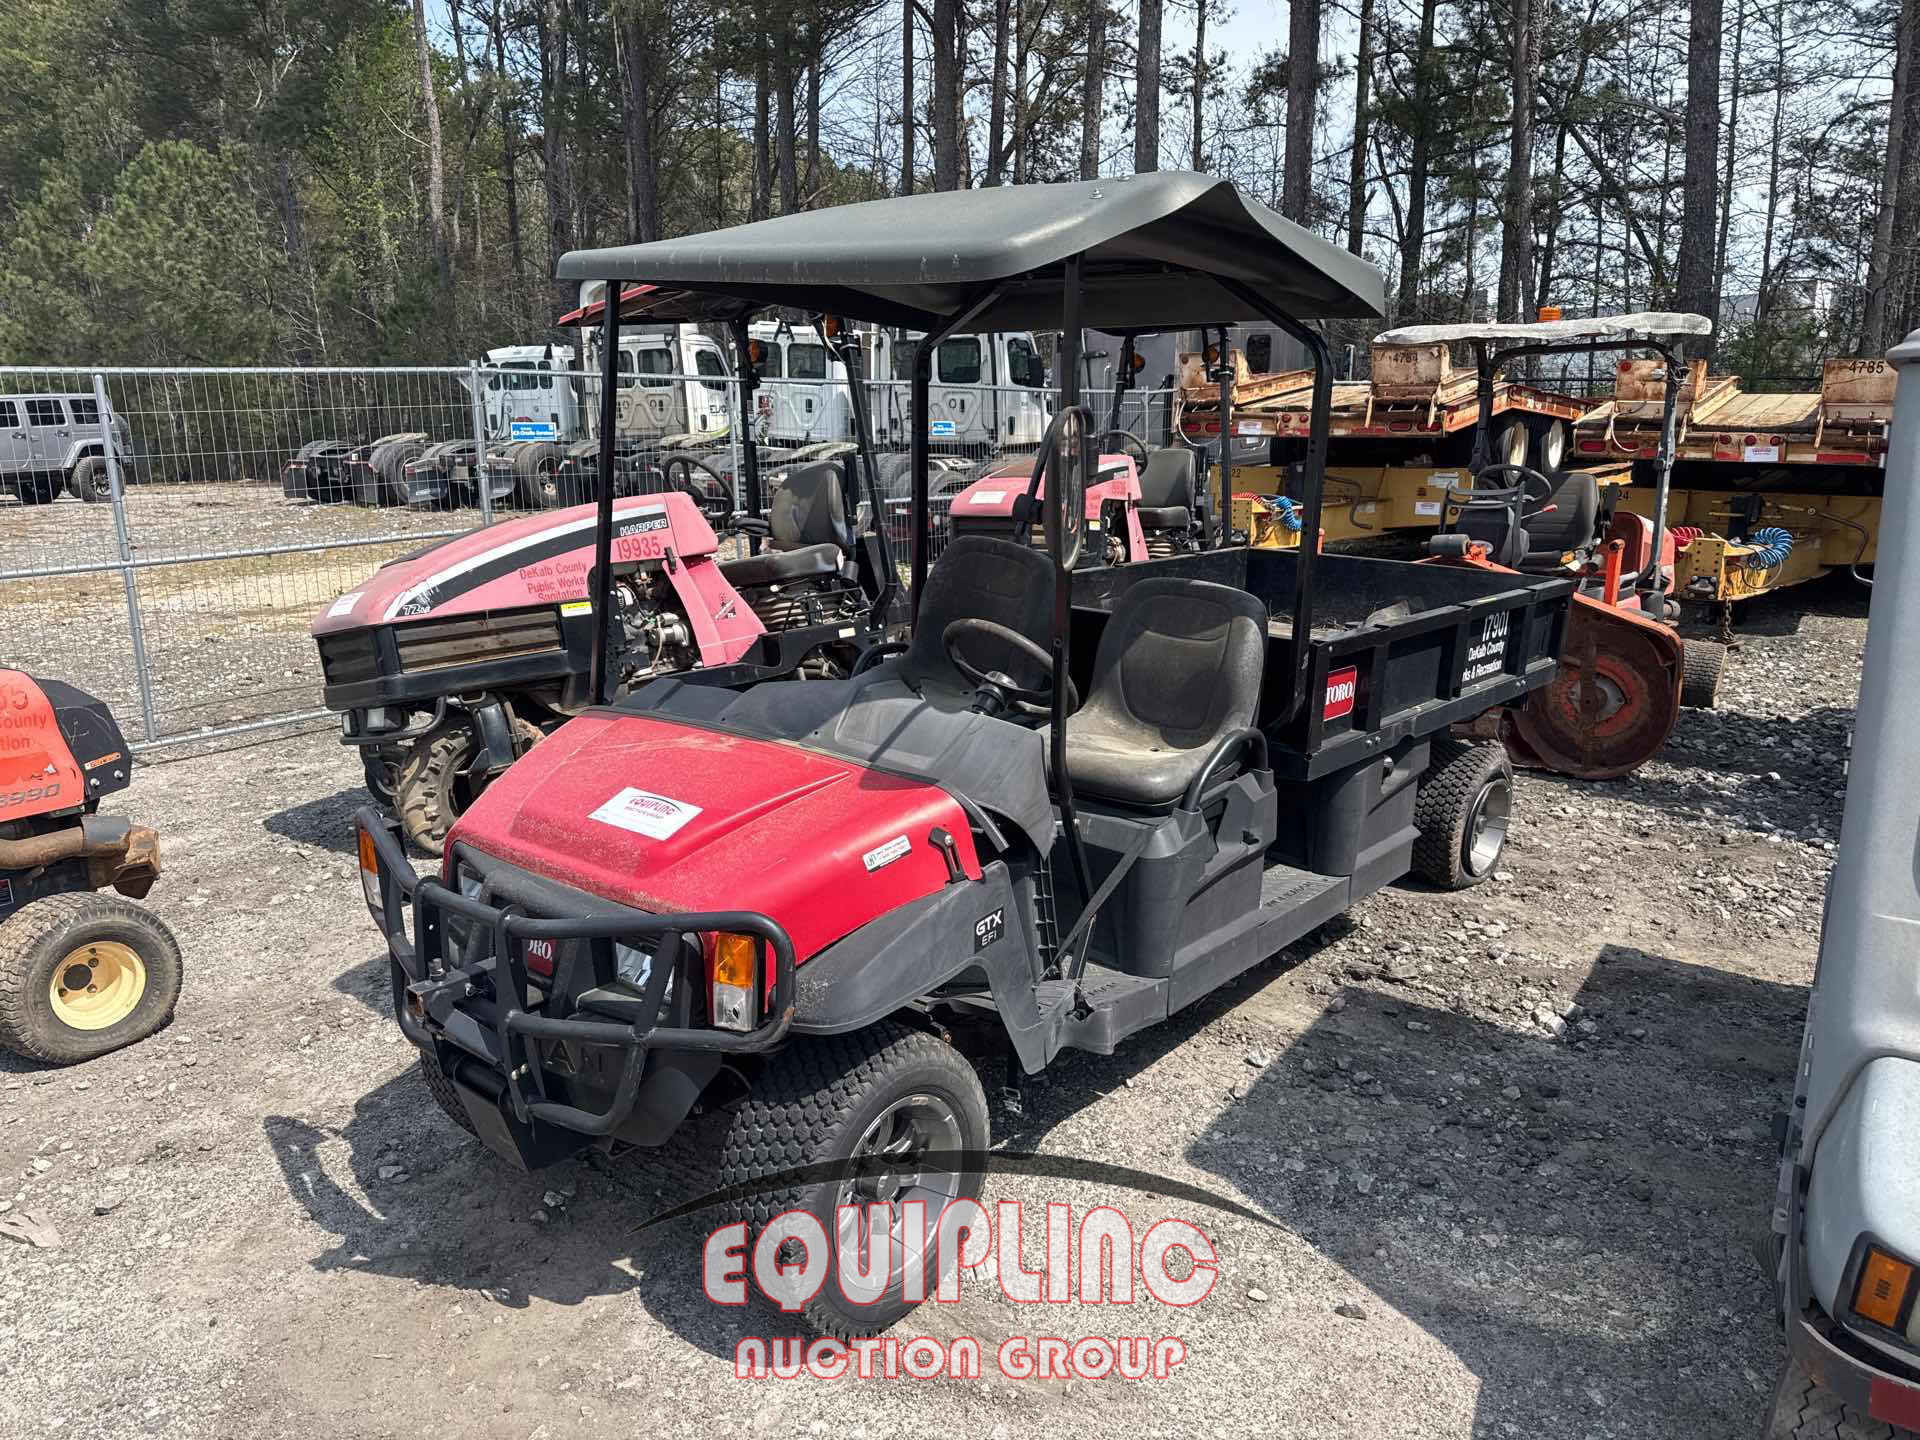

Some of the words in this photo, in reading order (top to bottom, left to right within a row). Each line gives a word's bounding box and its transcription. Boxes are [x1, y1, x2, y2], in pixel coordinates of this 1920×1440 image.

[1848, 360, 1885, 374] 4785
[619, 518, 669, 537] HARPER
[616, 536, 662, 560] 19935
[519, 565, 553, 580] DeKalb
[556, 562, 587, 576] County
[527, 580, 555, 594] Public
[559, 576, 586, 589] Works
[1481, 610, 1510, 642] 17901
[1468, 643, 1487, 661] DeKalb
[1487, 639, 1505, 655] County
[1476, 658, 1503, 677] Recreation
[1325, 681, 1353, 705] TORO
[976, 909, 1002, 936] GTX
[981, 929, 997, 946] EFI
